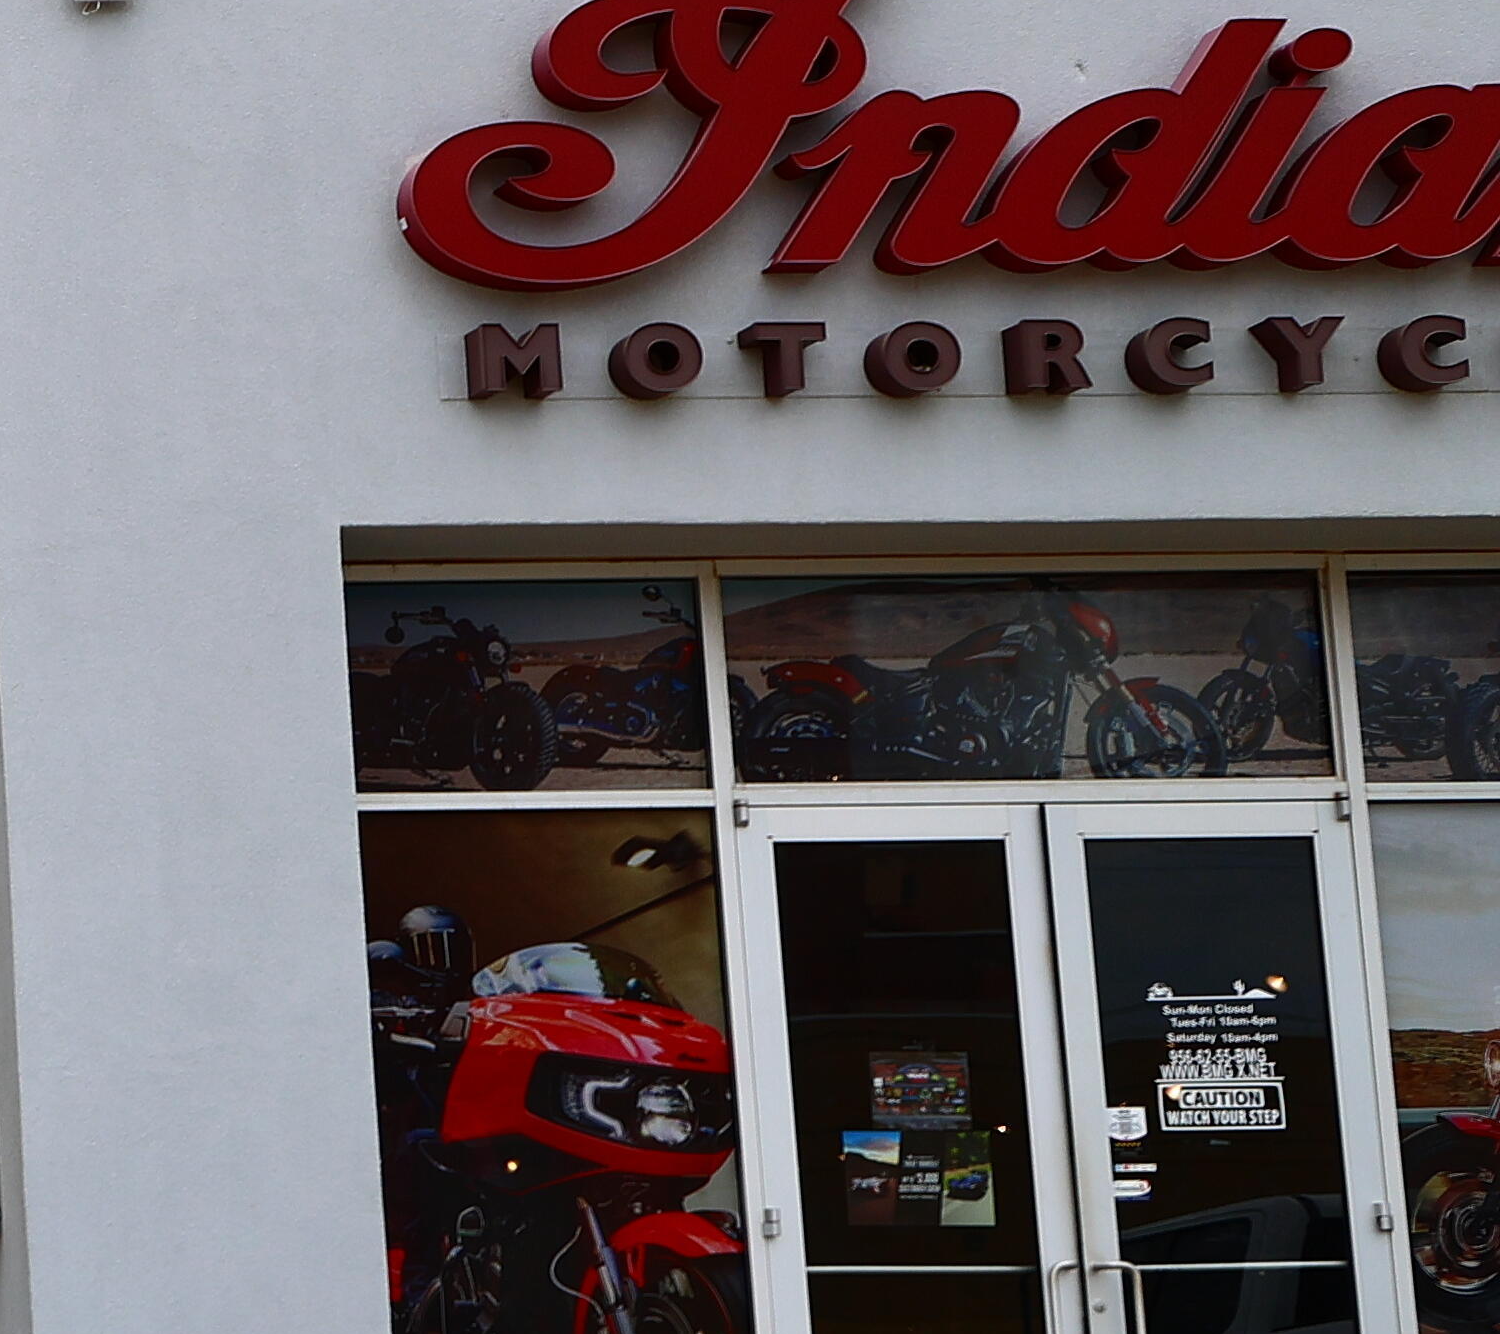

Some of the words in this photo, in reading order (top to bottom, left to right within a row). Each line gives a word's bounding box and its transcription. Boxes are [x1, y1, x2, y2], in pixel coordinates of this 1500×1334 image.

[1182, 1091, 1261, 1106] CAUTION
[1166, 1111, 1211, 1125] WATCH
[1212, 1110, 1247, 1125] YOUR
[1249, 1109, 1280, 1124] STEP
